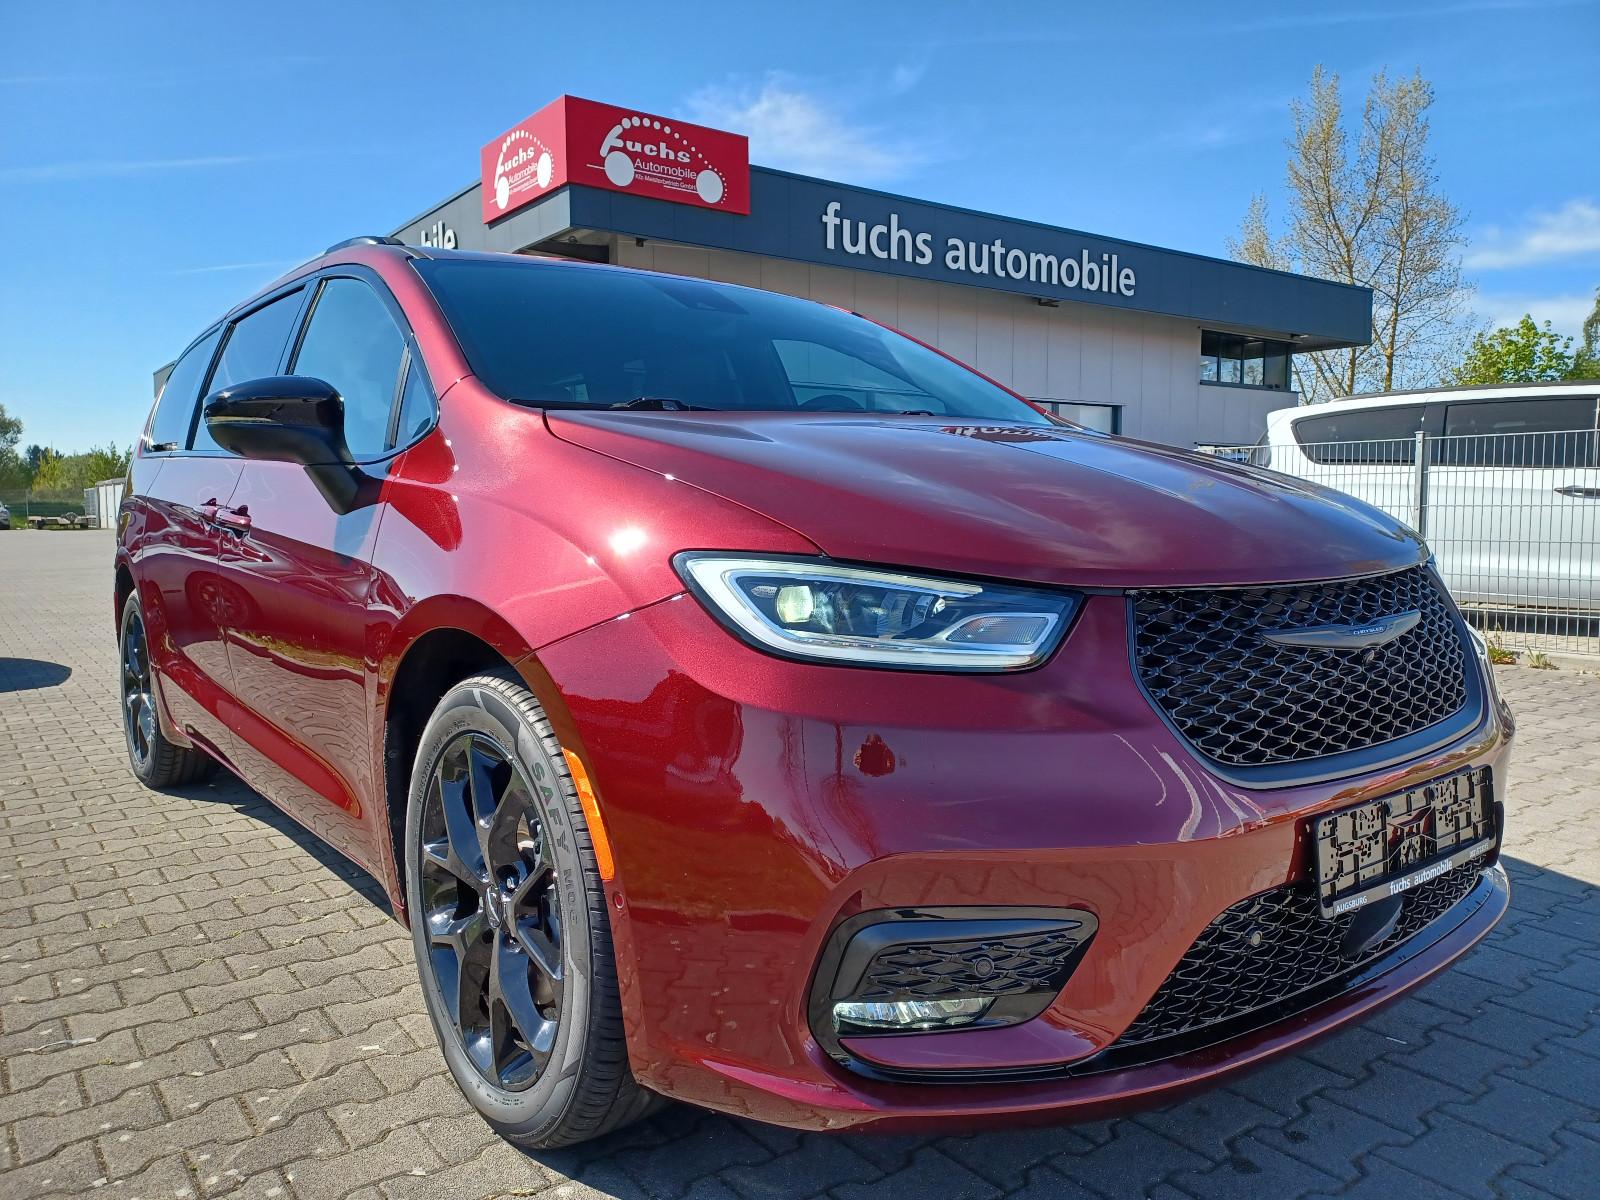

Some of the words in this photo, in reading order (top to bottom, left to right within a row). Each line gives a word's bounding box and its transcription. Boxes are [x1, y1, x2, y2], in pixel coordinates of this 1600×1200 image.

[634, 158, 697, 179] Automobile
[822, 201, 932, 265] fuchs
[945, 237, 1136, 296] automobile
[532, 762, 570, 853] SAFY
[1389, 877, 1411, 895] fuchs
[1414, 859, 1453, 885] automobile
[1335, 896, 1368, 913] AUGSBURG
